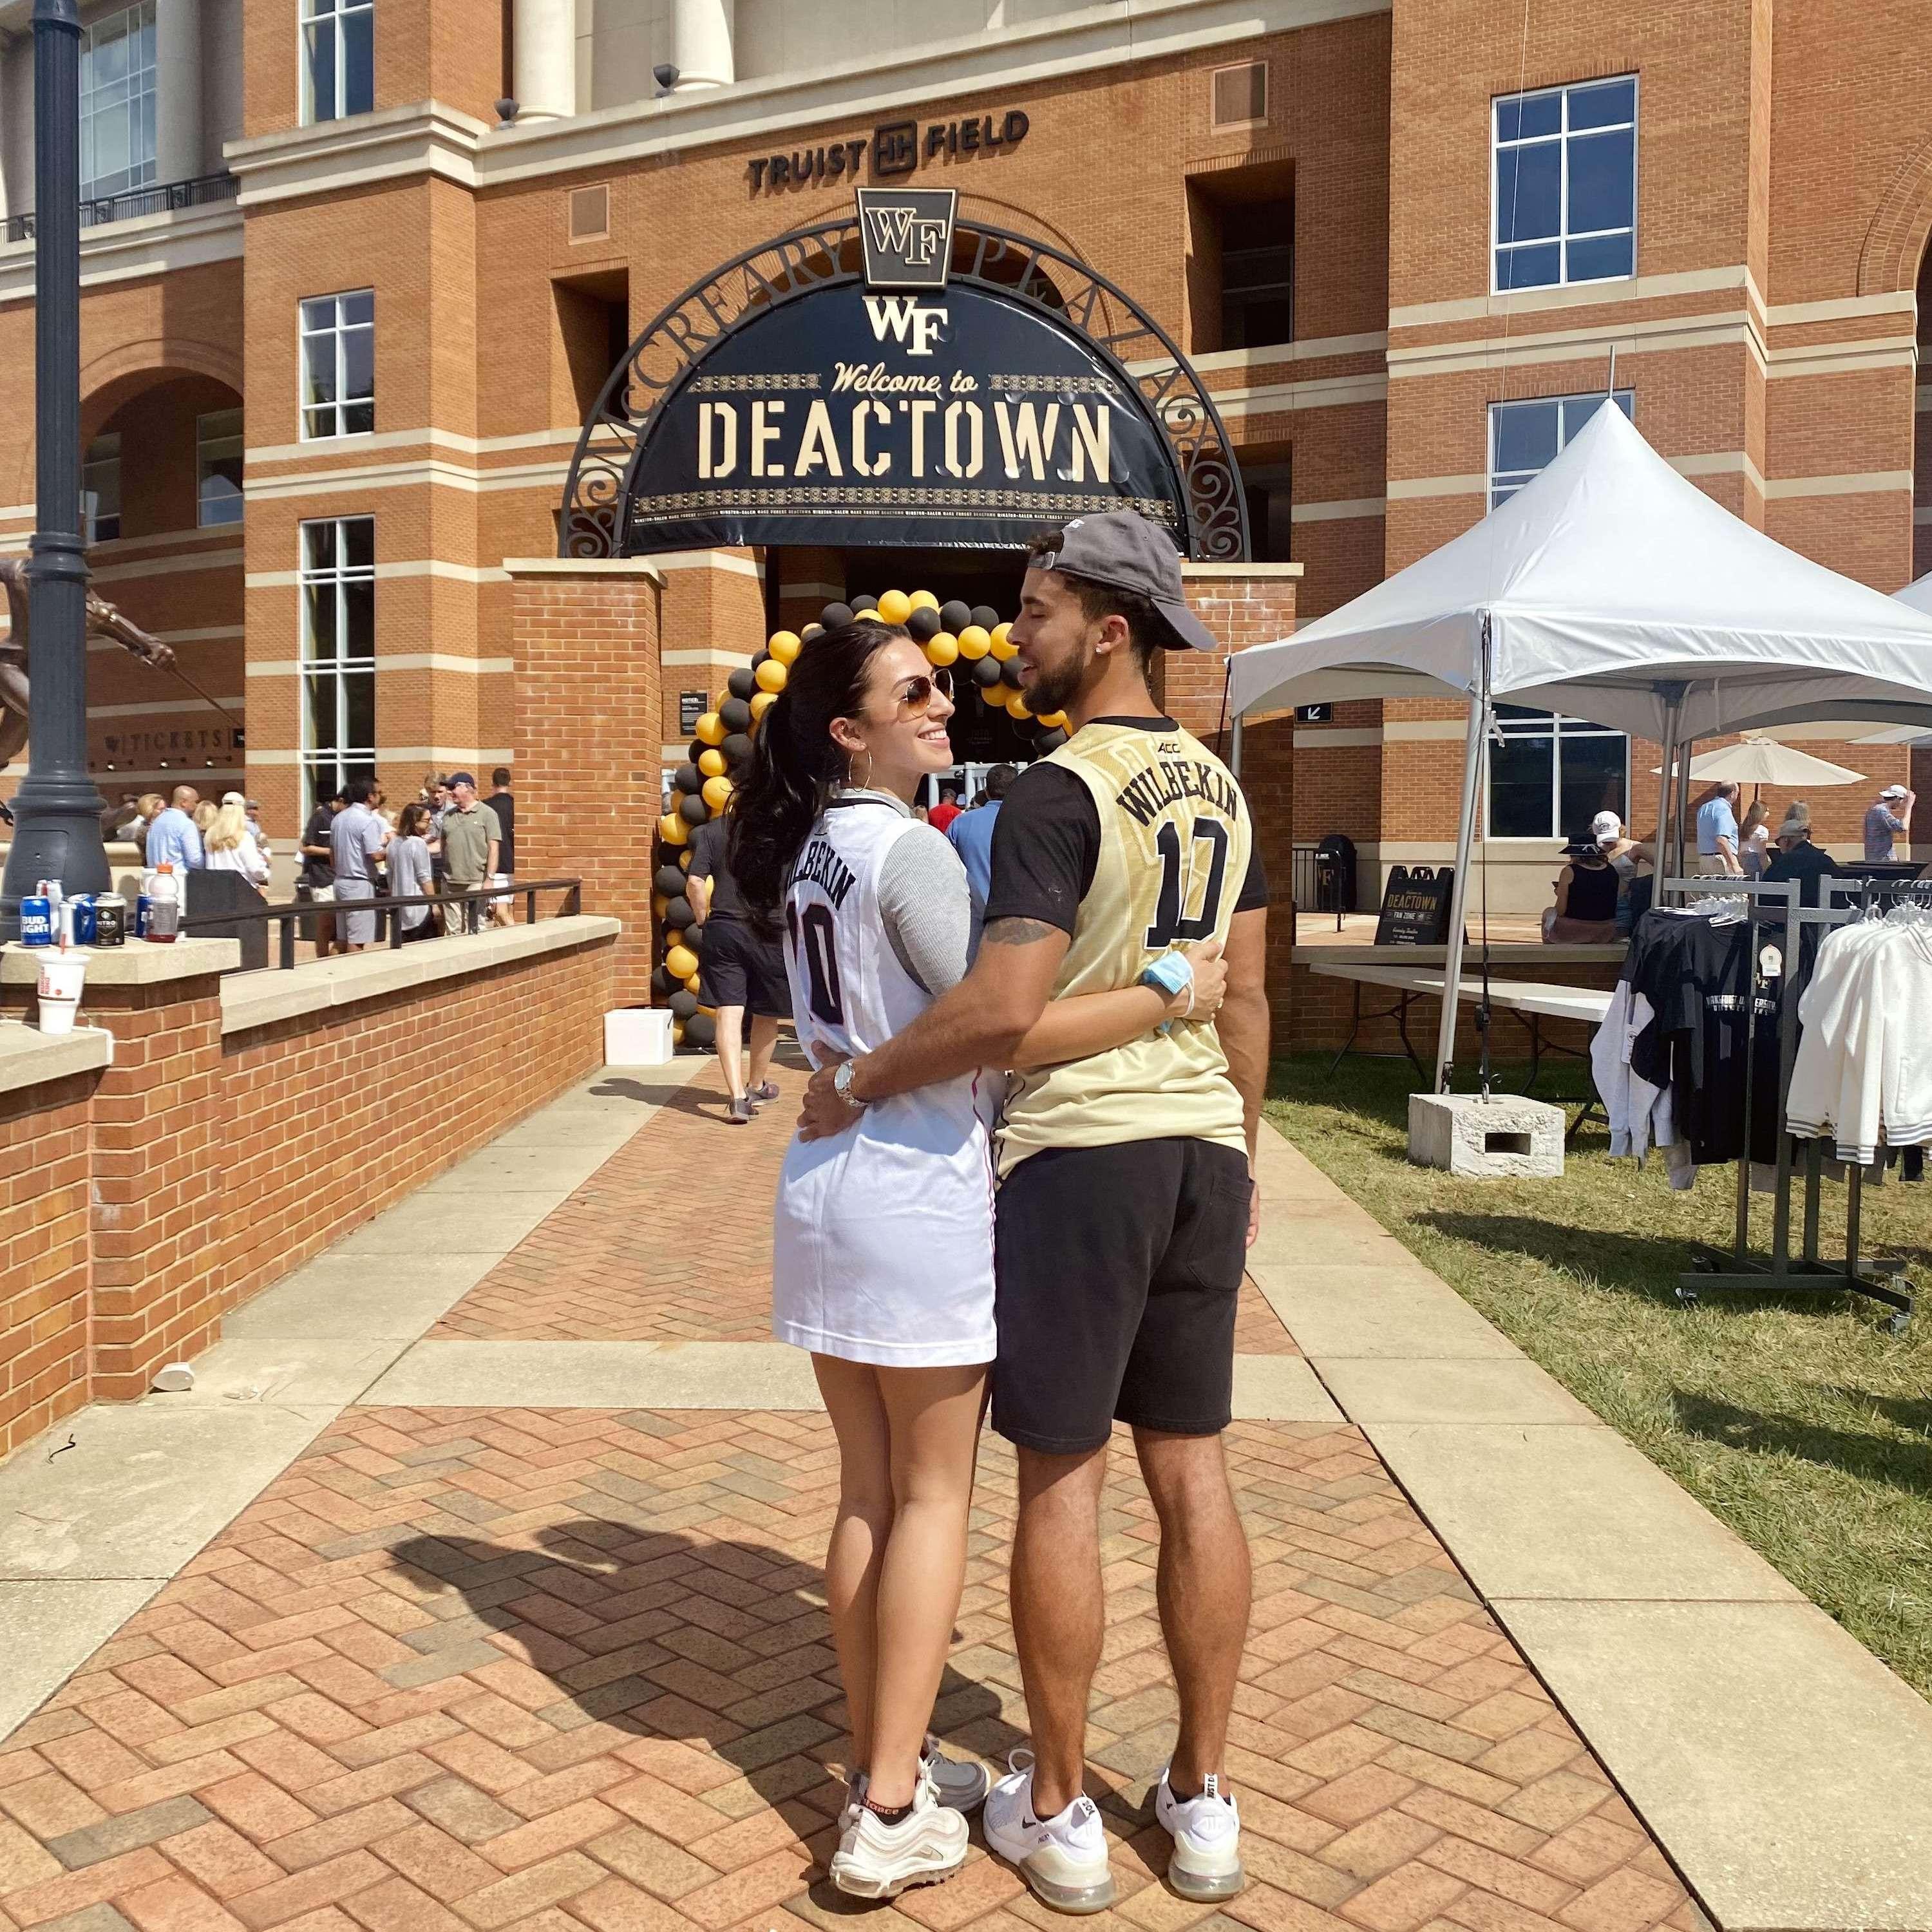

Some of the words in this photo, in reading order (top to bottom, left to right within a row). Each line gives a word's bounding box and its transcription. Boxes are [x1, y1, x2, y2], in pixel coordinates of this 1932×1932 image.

[748, 139, 867, 188] TRUIST
[927, 109, 1030, 156] FIELD
[865, 207, 947, 266] WF
[861, 295, 948, 355] WF
[958, 229, 1182, 406] PLAZA
[831, 361, 942, 392] Welcome
[949, 369, 979, 393] to
[698, 399, 1110, 484] DEACTOWN
[130, 730, 222, 750] TICKETS
[1158, 742, 1180, 753] ACC
[1115, 761, 1236, 828] WILBEKIN
[788, 841, 857, 911] ILBEKIN
[1143, 815, 1229, 951] 10
[1387, 894, 1437, 911] DEACTOWN
[21, 915, 46, 925] BUD
